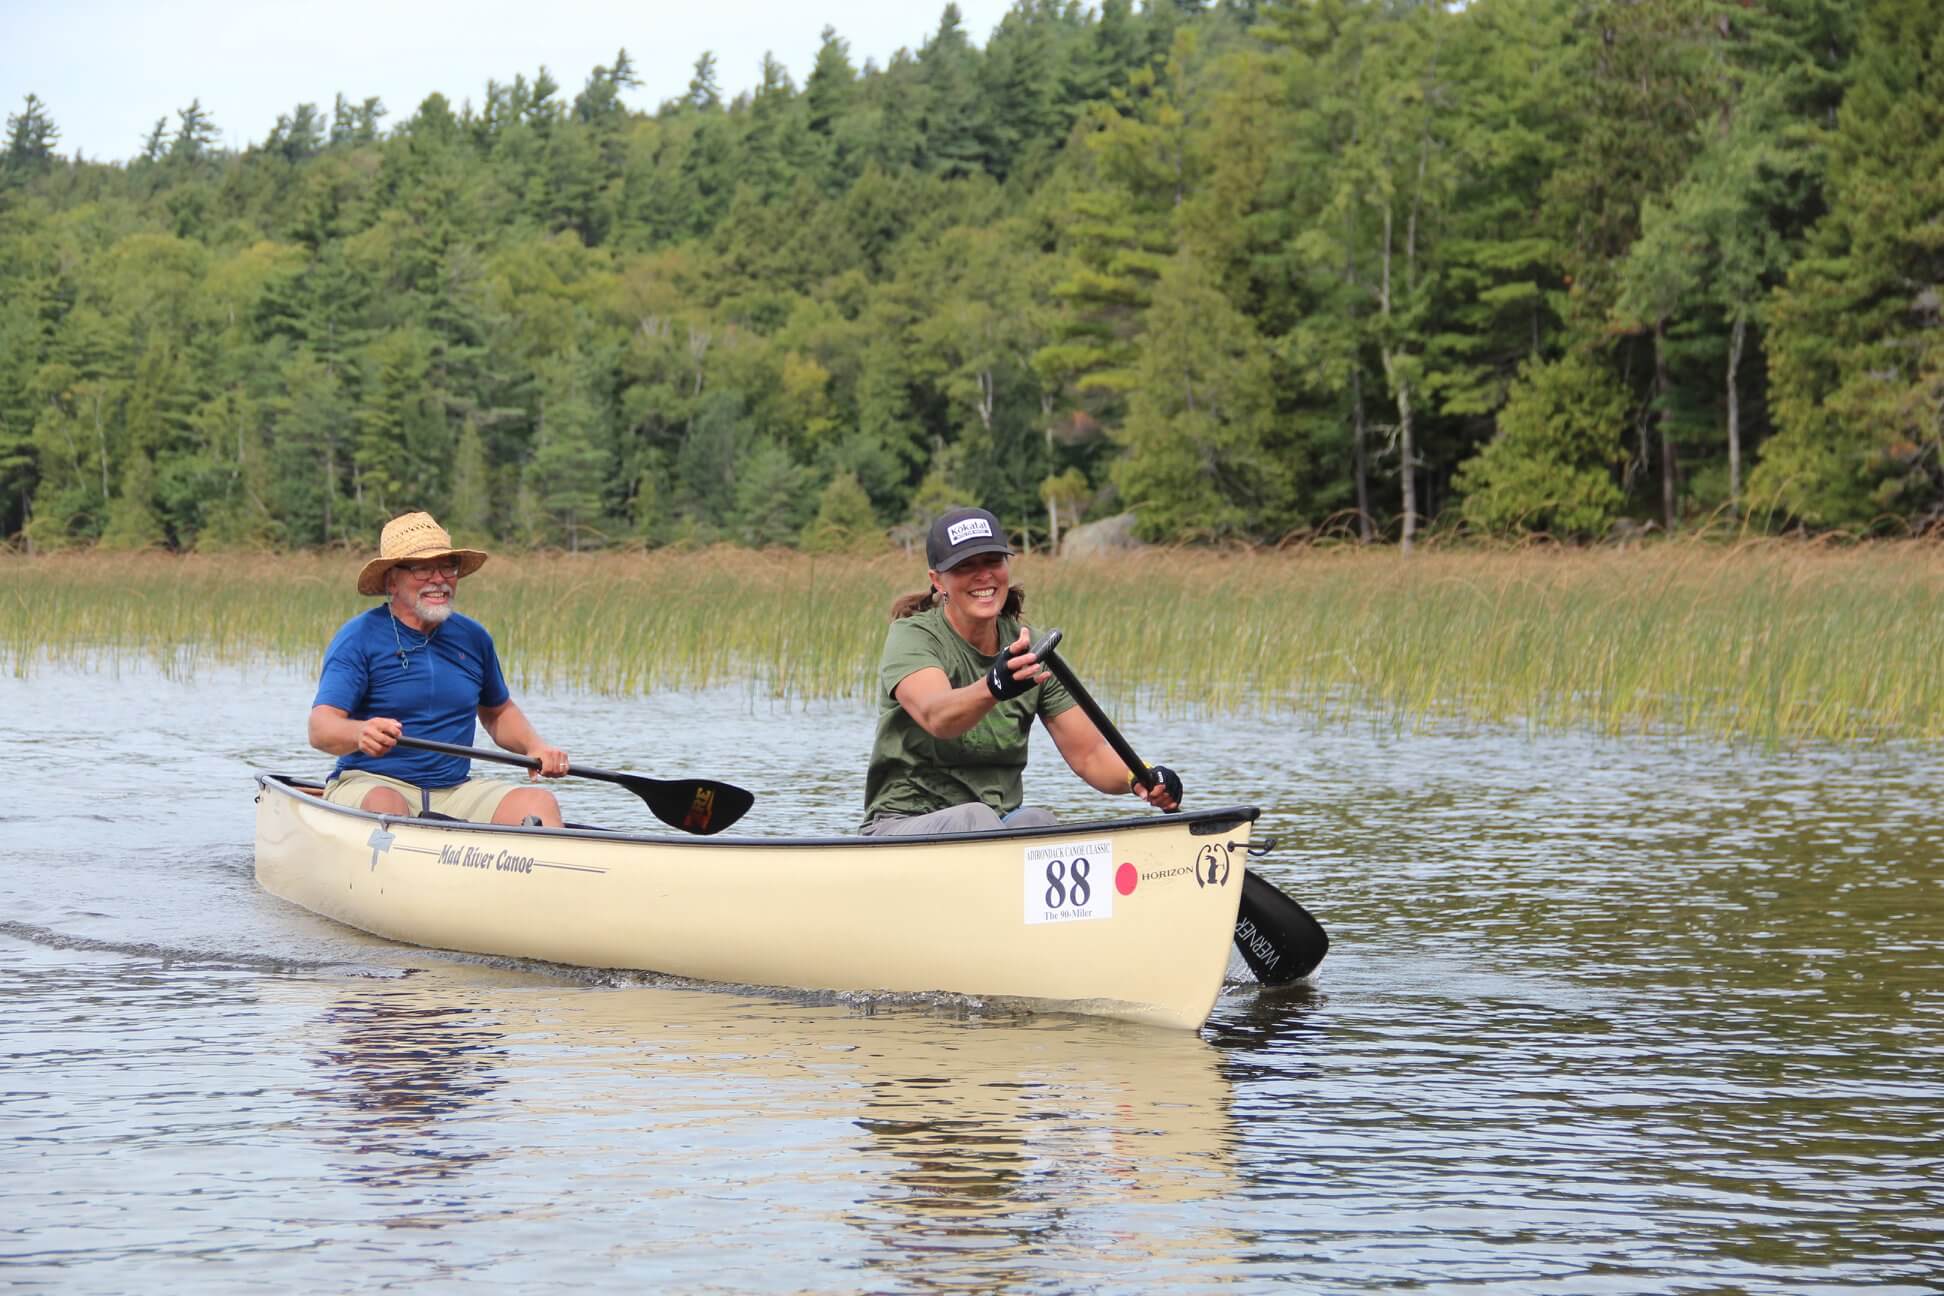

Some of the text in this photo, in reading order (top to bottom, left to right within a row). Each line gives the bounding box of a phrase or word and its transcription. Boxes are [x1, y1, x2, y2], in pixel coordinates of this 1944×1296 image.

[438, 844, 534, 874] Mad River Canoe
[1027, 842, 1111, 861] ADIRONDACK CANOE CLASSIC
[1045, 857, 1091, 909] 88
[1141, 866, 1194, 881] HORIZON
[1045, 908, 1093, 921] The 90-Miler
[1235, 917, 1280, 970] WERNER
